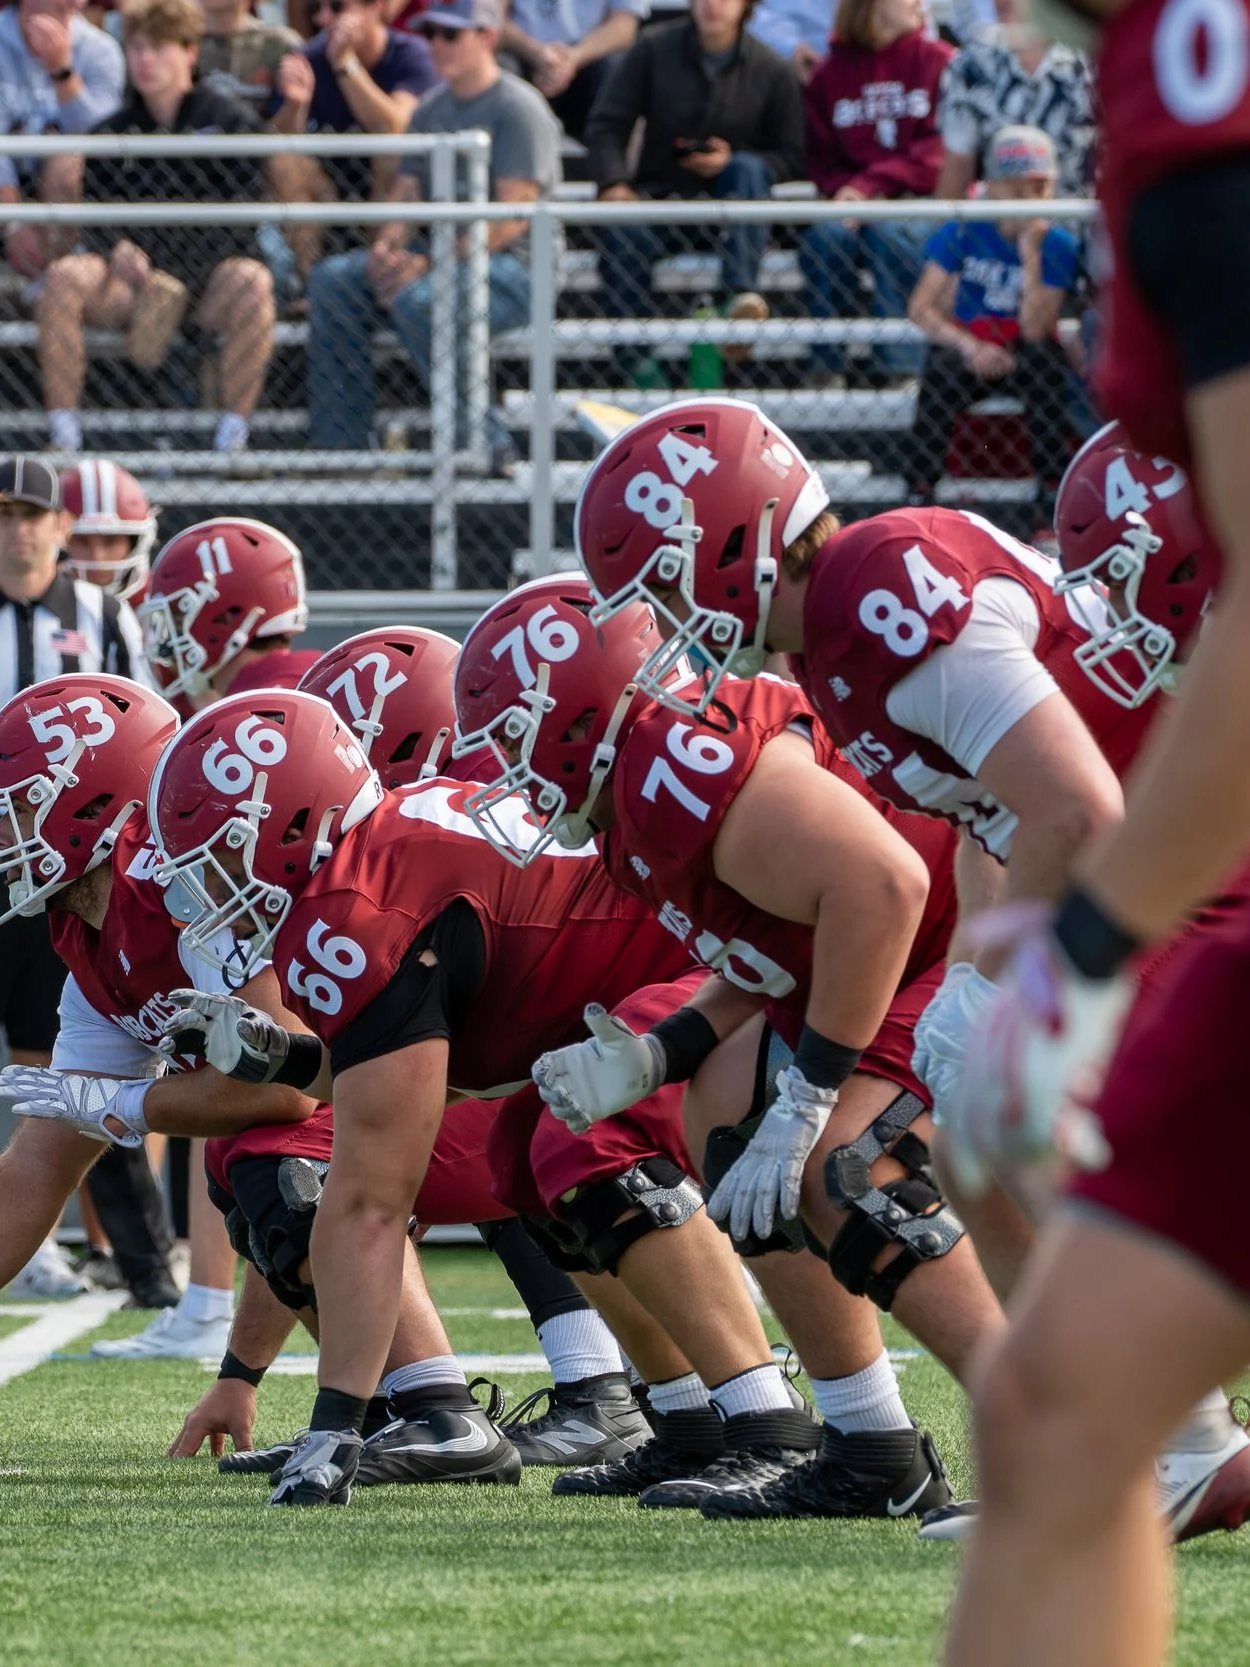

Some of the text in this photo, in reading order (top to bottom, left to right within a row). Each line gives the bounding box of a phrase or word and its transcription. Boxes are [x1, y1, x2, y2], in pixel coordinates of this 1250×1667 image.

[625, 433, 719, 529] 84
[196, 536, 234, 576] 11
[859, 544, 970, 657] 84
[326, 652, 407, 720] 72
[491, 604, 579, 690] 76
[29, 696, 116, 764] 53
[202, 714, 287, 795] 66
[641, 721, 734, 822] 76
[287, 918, 367, 1016] 66
